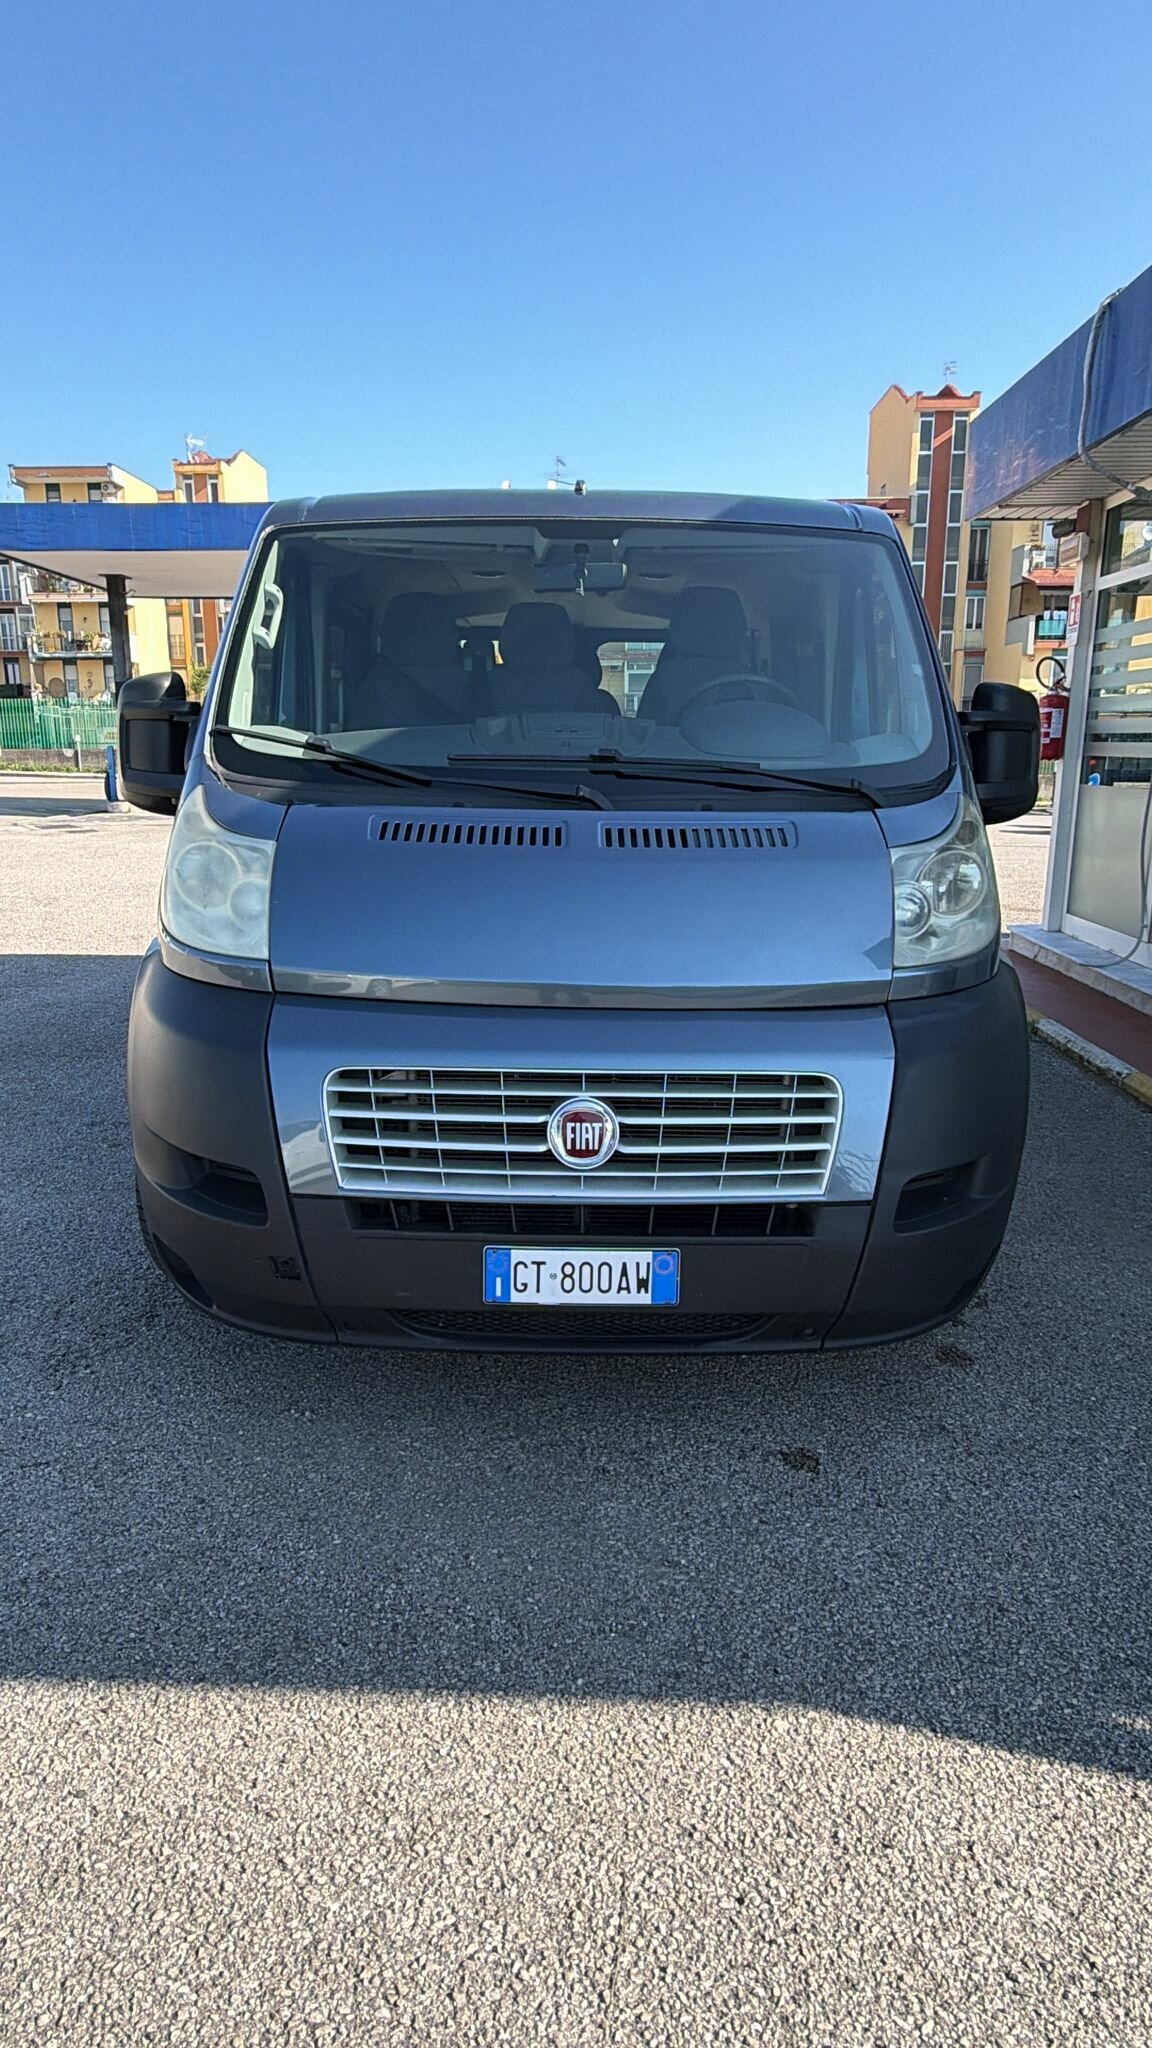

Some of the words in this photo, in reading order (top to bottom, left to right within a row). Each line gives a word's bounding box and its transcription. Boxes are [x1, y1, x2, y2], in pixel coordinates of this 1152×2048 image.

[566, 1122, 603, 1151] FIAT
[513, 1260, 547, 1294] GT
[560, 1261, 651, 1295] 800AW
